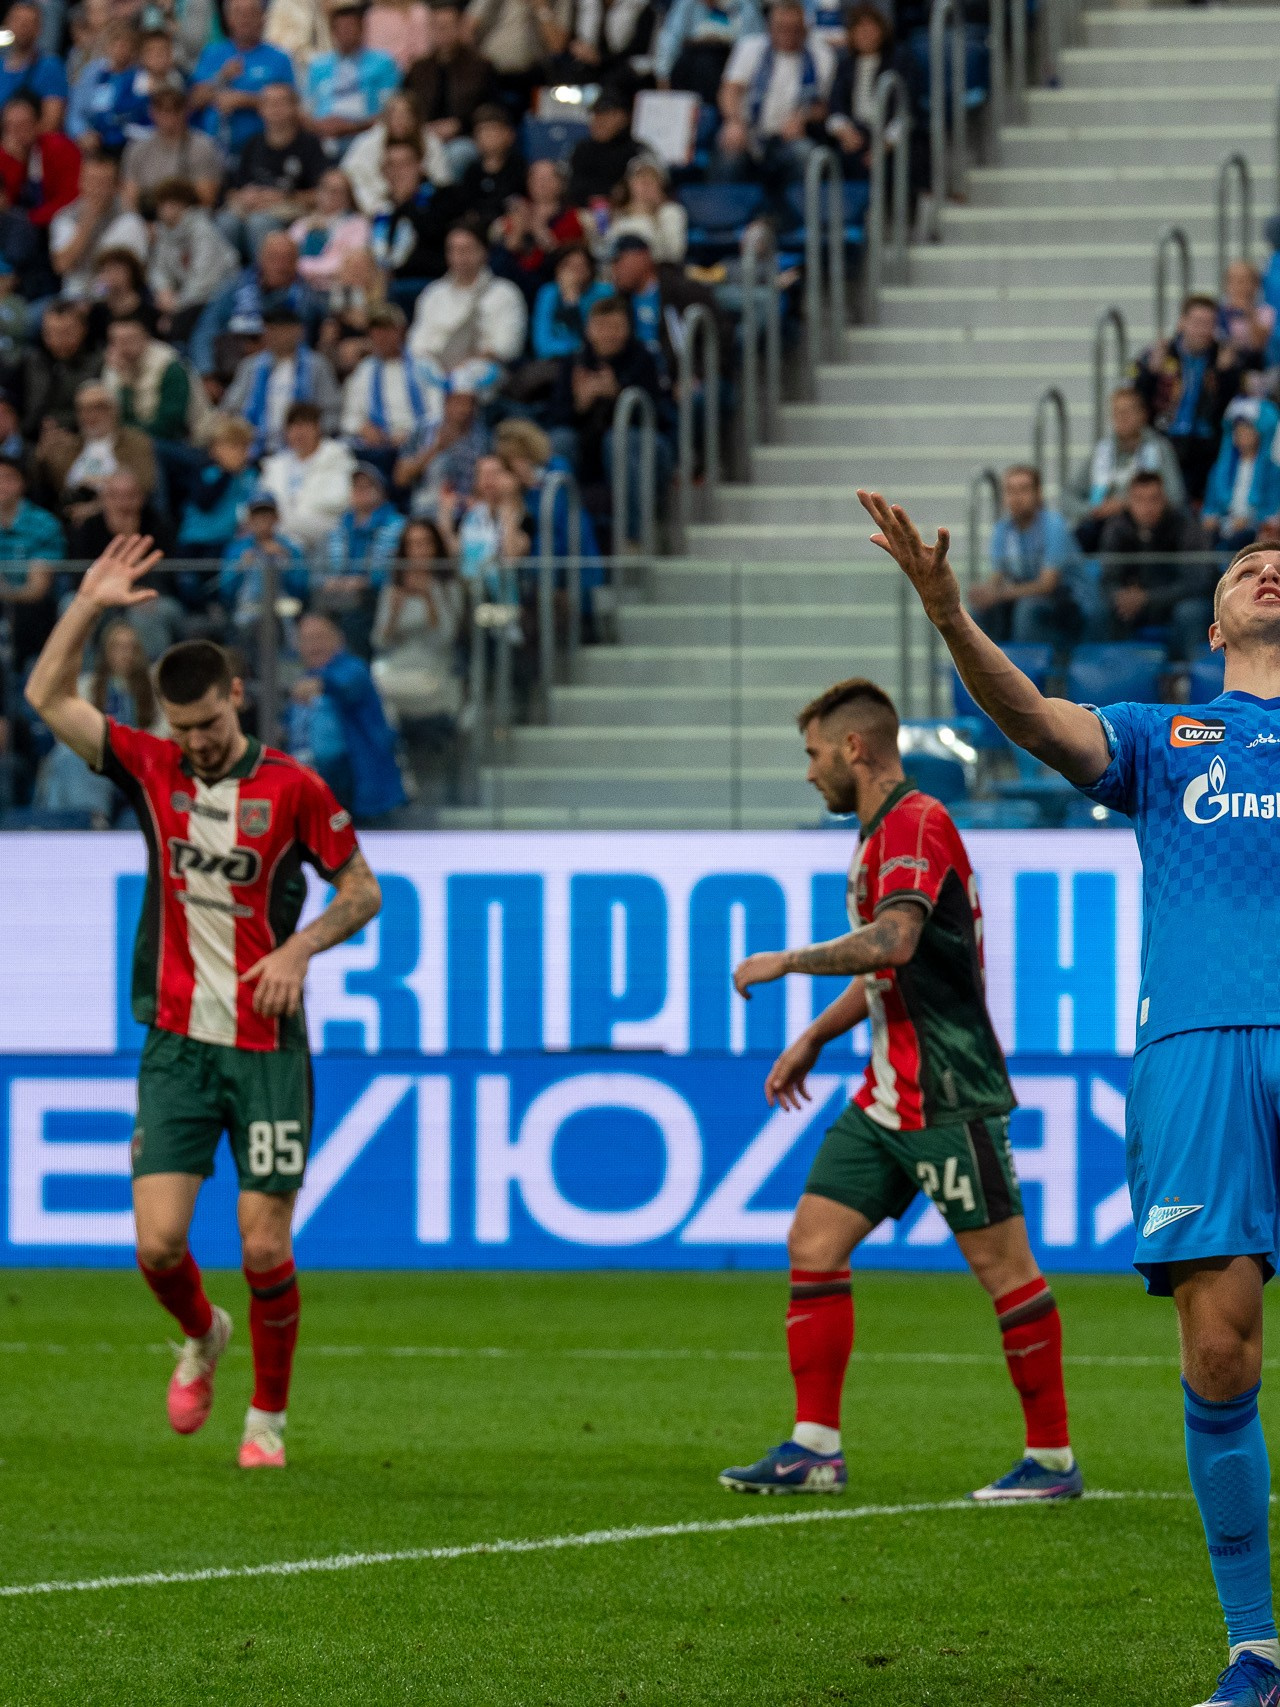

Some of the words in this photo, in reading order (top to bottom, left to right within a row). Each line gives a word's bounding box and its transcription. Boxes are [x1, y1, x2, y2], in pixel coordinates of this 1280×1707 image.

[1185, 729, 1223, 740] WIN
[115, 871, 872, 1054] ЗПРО
[248, 1120, 304, 1176] 85
[290, 1074, 1138, 1247] ЛЮДЯ
[916, 1157, 976, 1212] 24
